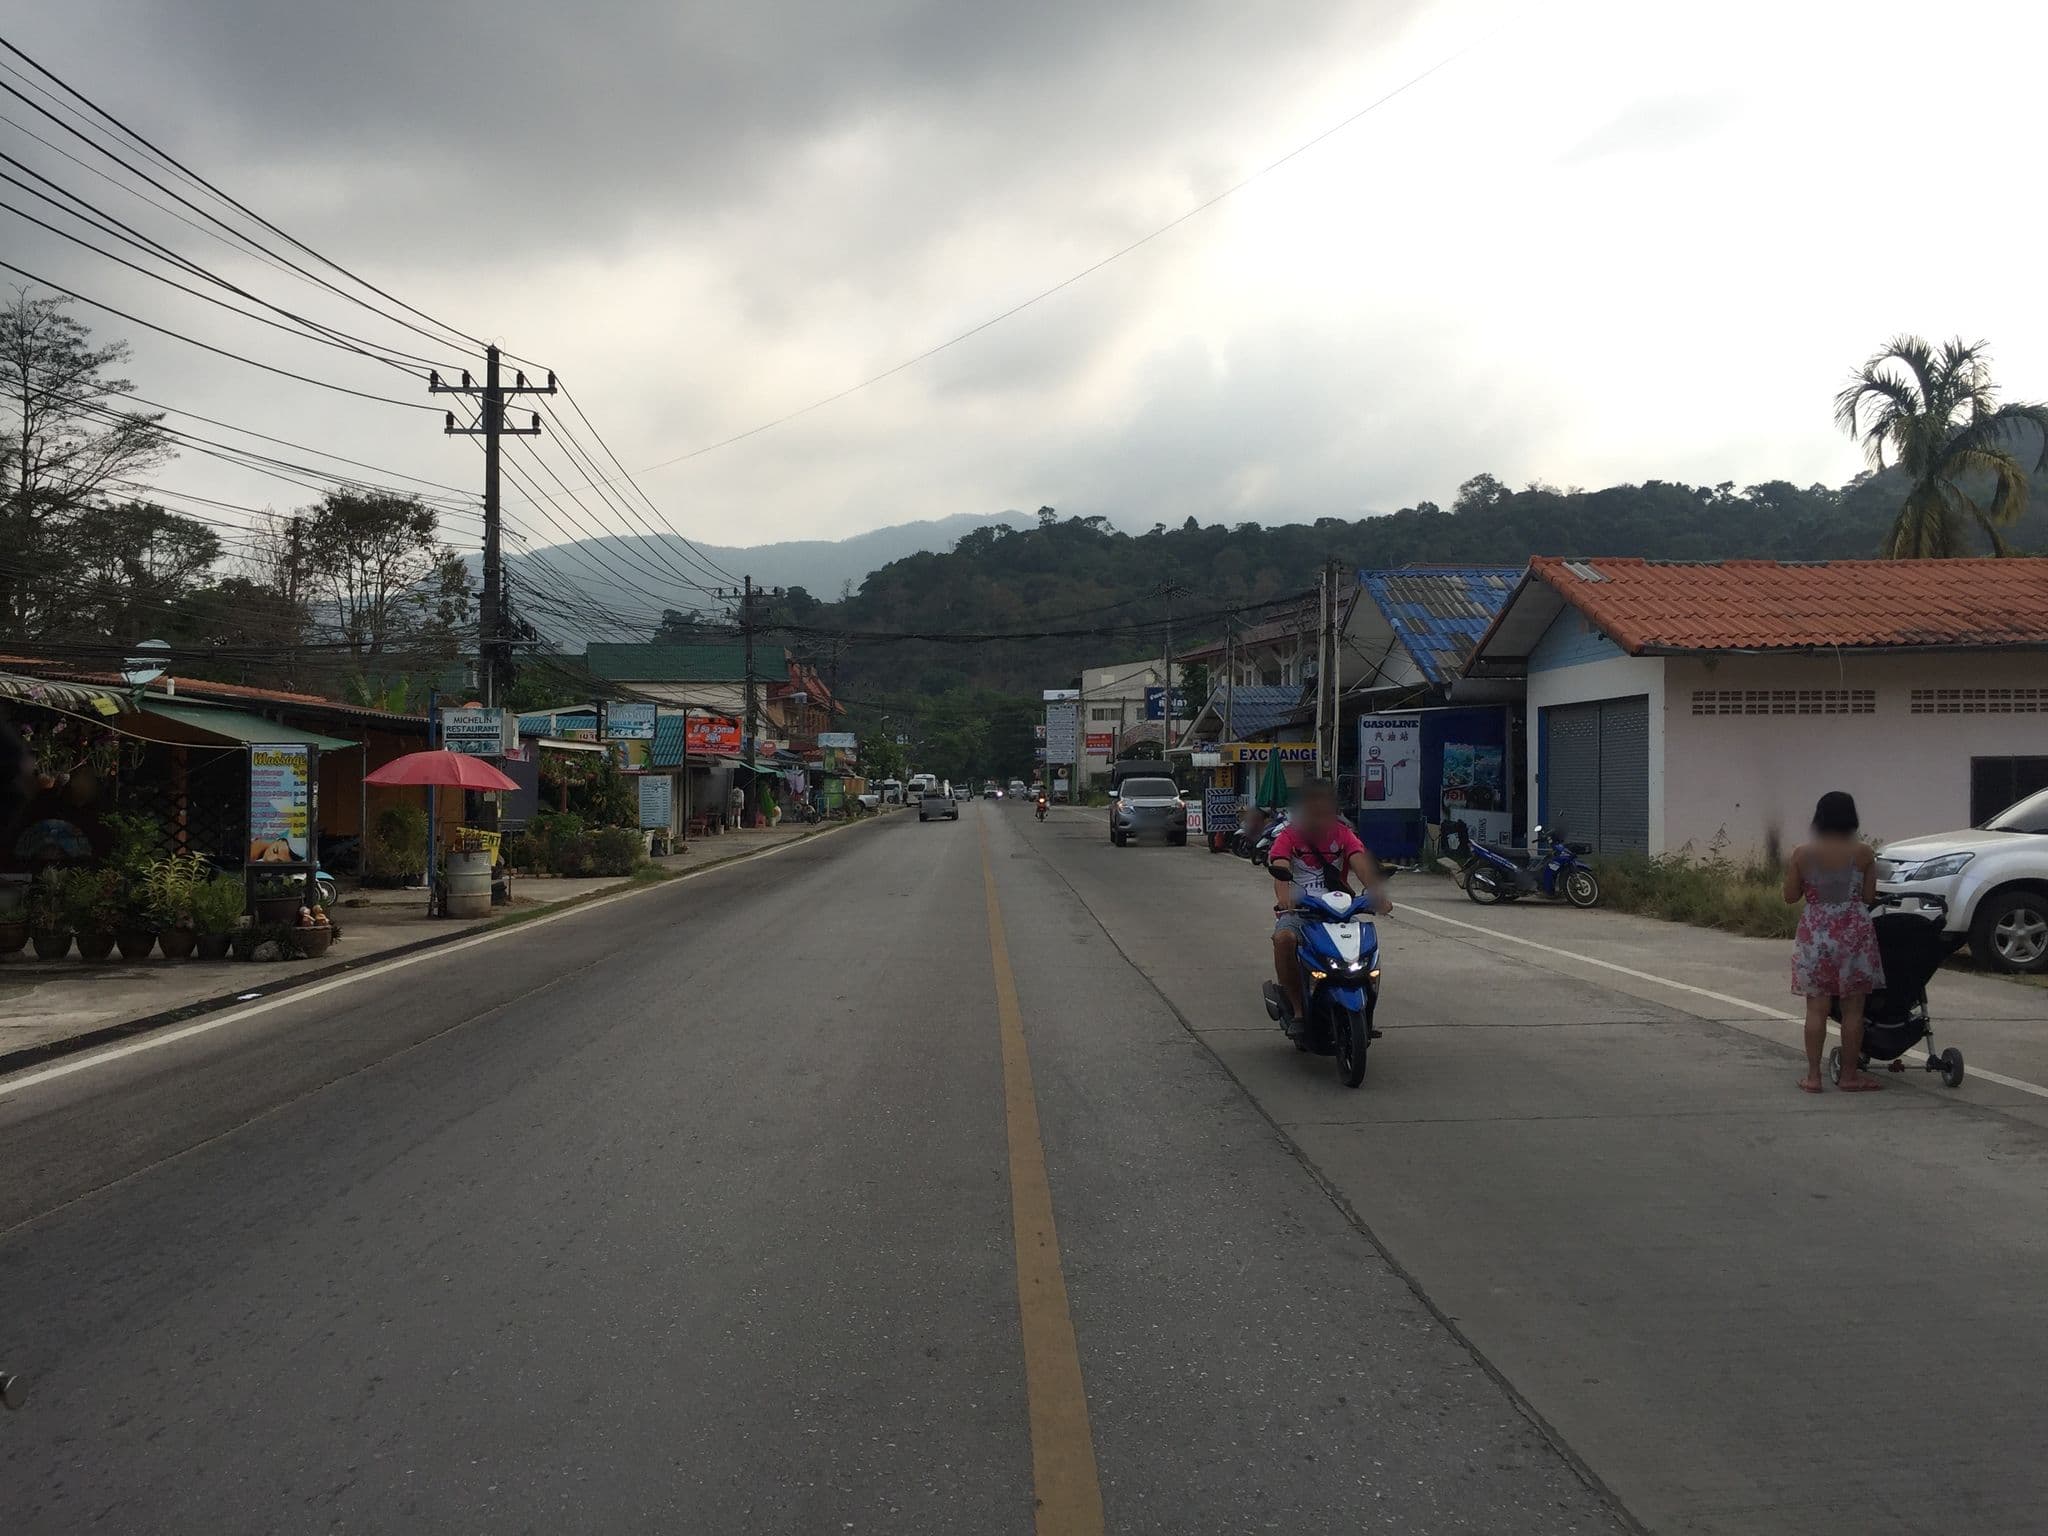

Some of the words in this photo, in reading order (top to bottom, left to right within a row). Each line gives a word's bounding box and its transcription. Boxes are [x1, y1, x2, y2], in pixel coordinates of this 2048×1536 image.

[453, 716, 493, 724] MICHELIN
[1363, 720, 1420, 729] GASOLINE
[446, 725, 500, 733] RESTAURANT
[1239, 748, 1318, 761] EXCANGE
[253, 752, 308, 769] Massage
